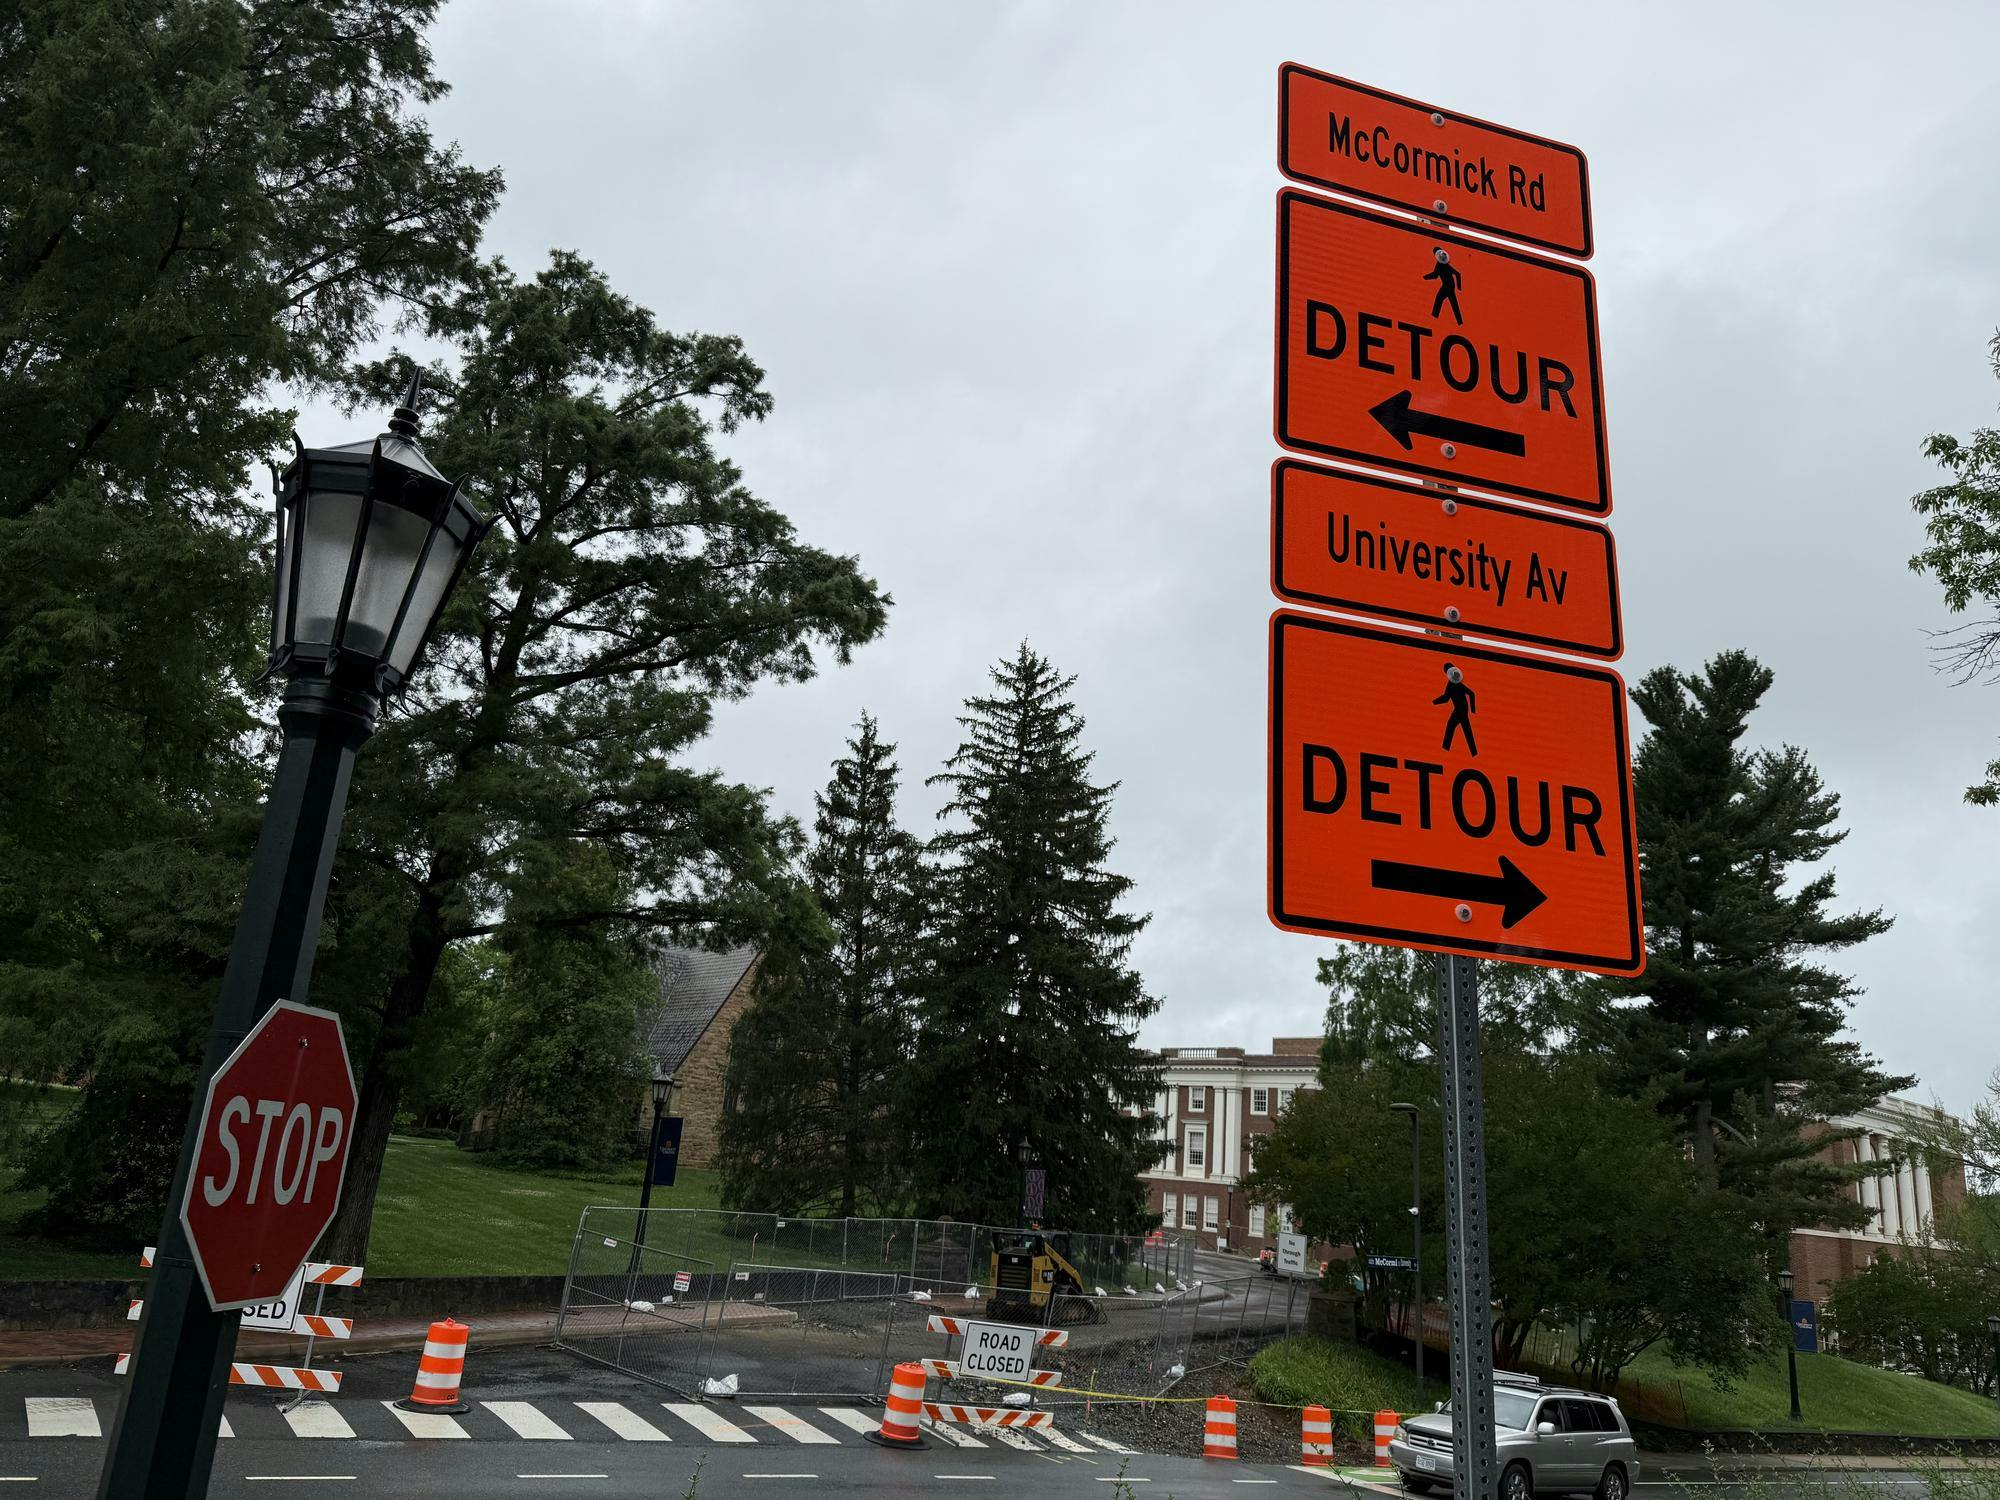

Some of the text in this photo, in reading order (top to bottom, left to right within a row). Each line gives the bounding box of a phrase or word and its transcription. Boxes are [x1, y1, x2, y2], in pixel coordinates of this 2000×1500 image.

[1329, 111, 1546, 212] McCormick Rd
[1306, 299, 1578, 419] DETOUR
[1328, 511, 1568, 607] University Av
[1302, 742, 1606, 857] DETOUR
[203, 1095, 344, 1207] STOP
[967, 1353, 1024, 1374] CLOSED
[979, 1332, 1021, 1351] ROAD
